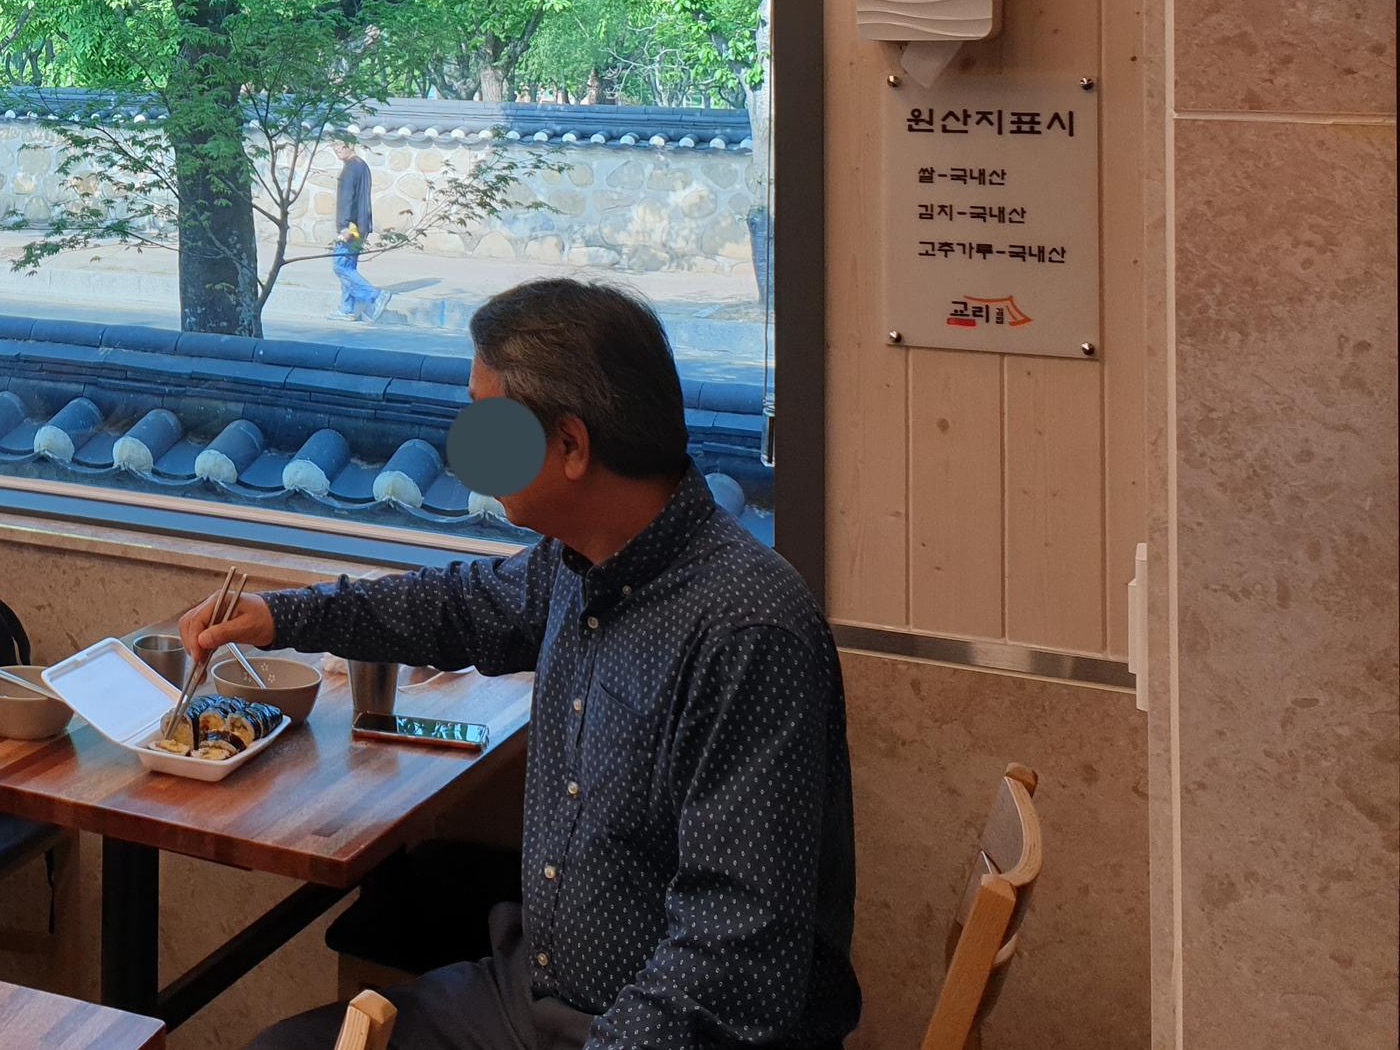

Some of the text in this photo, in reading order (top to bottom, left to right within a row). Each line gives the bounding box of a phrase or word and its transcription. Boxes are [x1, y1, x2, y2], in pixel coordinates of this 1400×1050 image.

[906, 107, 1075, 137] 원산지표시
[918, 167, 1007, 186] 쌀-국내산
[918, 241, 1067, 264] 고추가루-국내산
[950, 301, 990, 324] 교리
